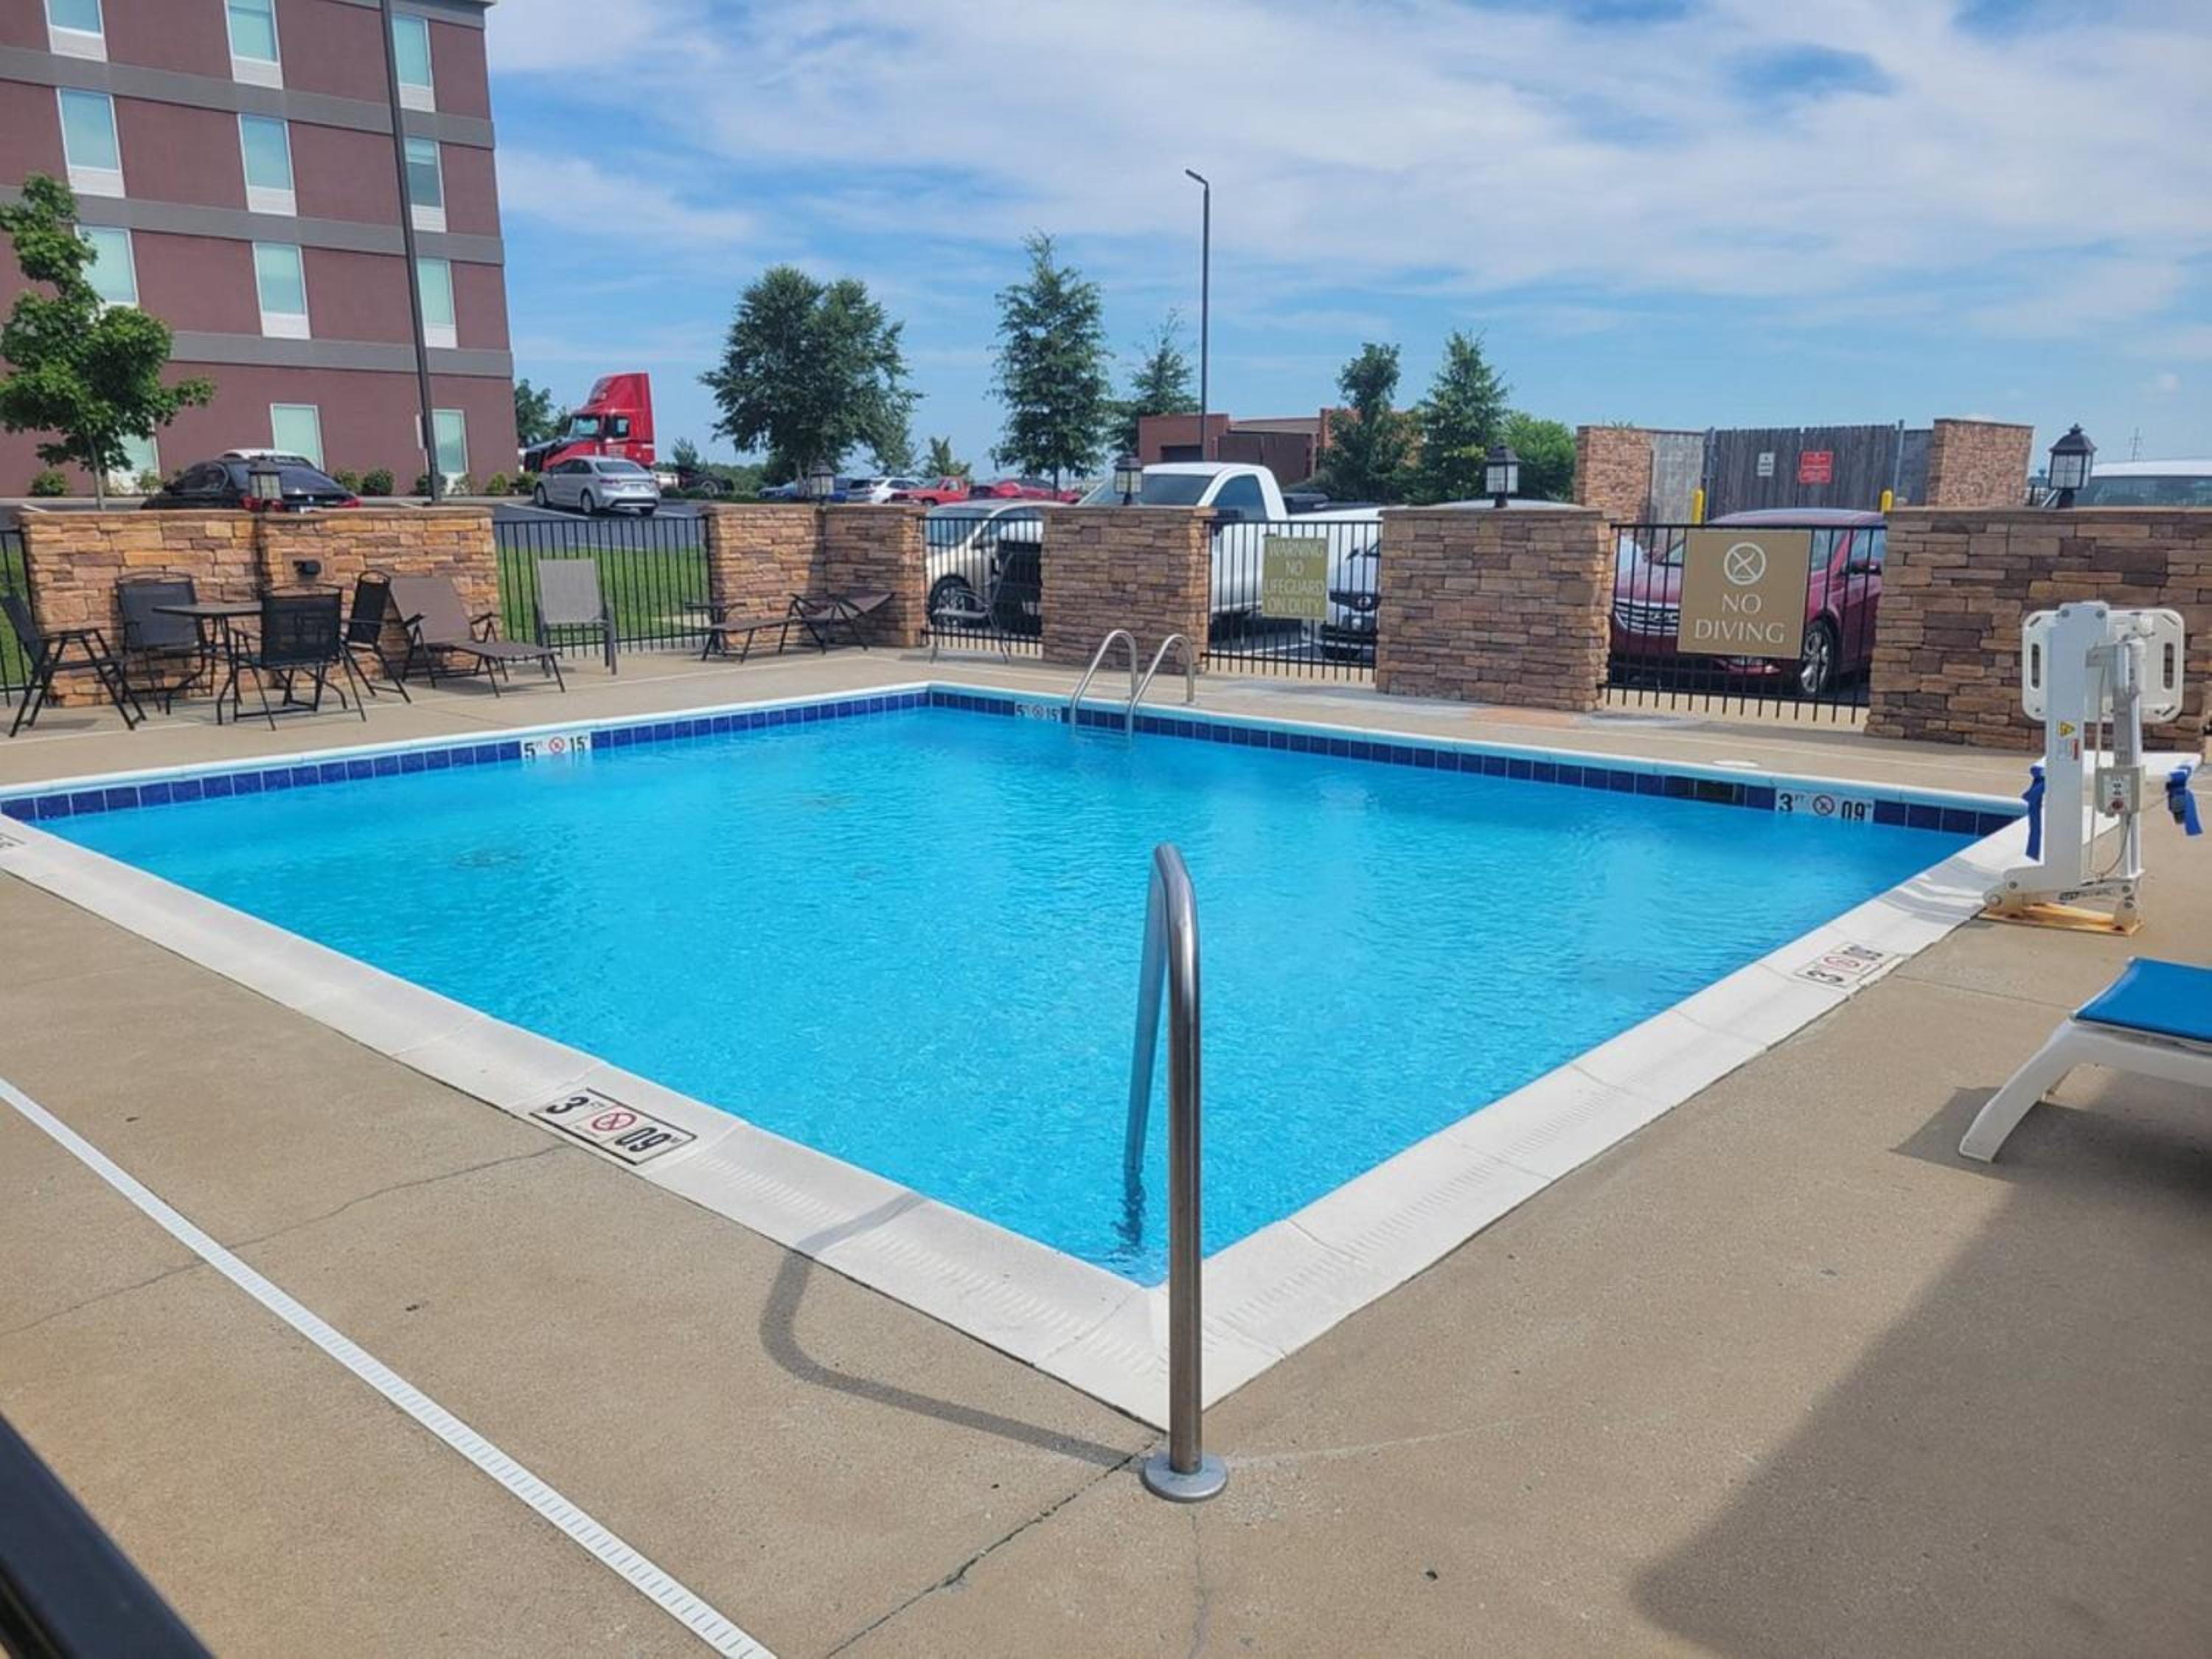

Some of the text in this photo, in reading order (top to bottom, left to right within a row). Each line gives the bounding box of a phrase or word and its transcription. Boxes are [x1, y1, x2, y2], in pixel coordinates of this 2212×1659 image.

[1268, 542, 1325, 558] WARNING
[1284, 560, 1305, 576] NO
[1267, 597, 1323, 615] ON DUTY
[1722, 593, 1762, 614] NO
[1695, 618, 1785, 644] DIVING
[1779, 793, 1792, 812] 3
[1842, 800, 1865, 821] 09
[546, 1096, 589, 1114] 3
[614, 1127, 672, 1152] 09
